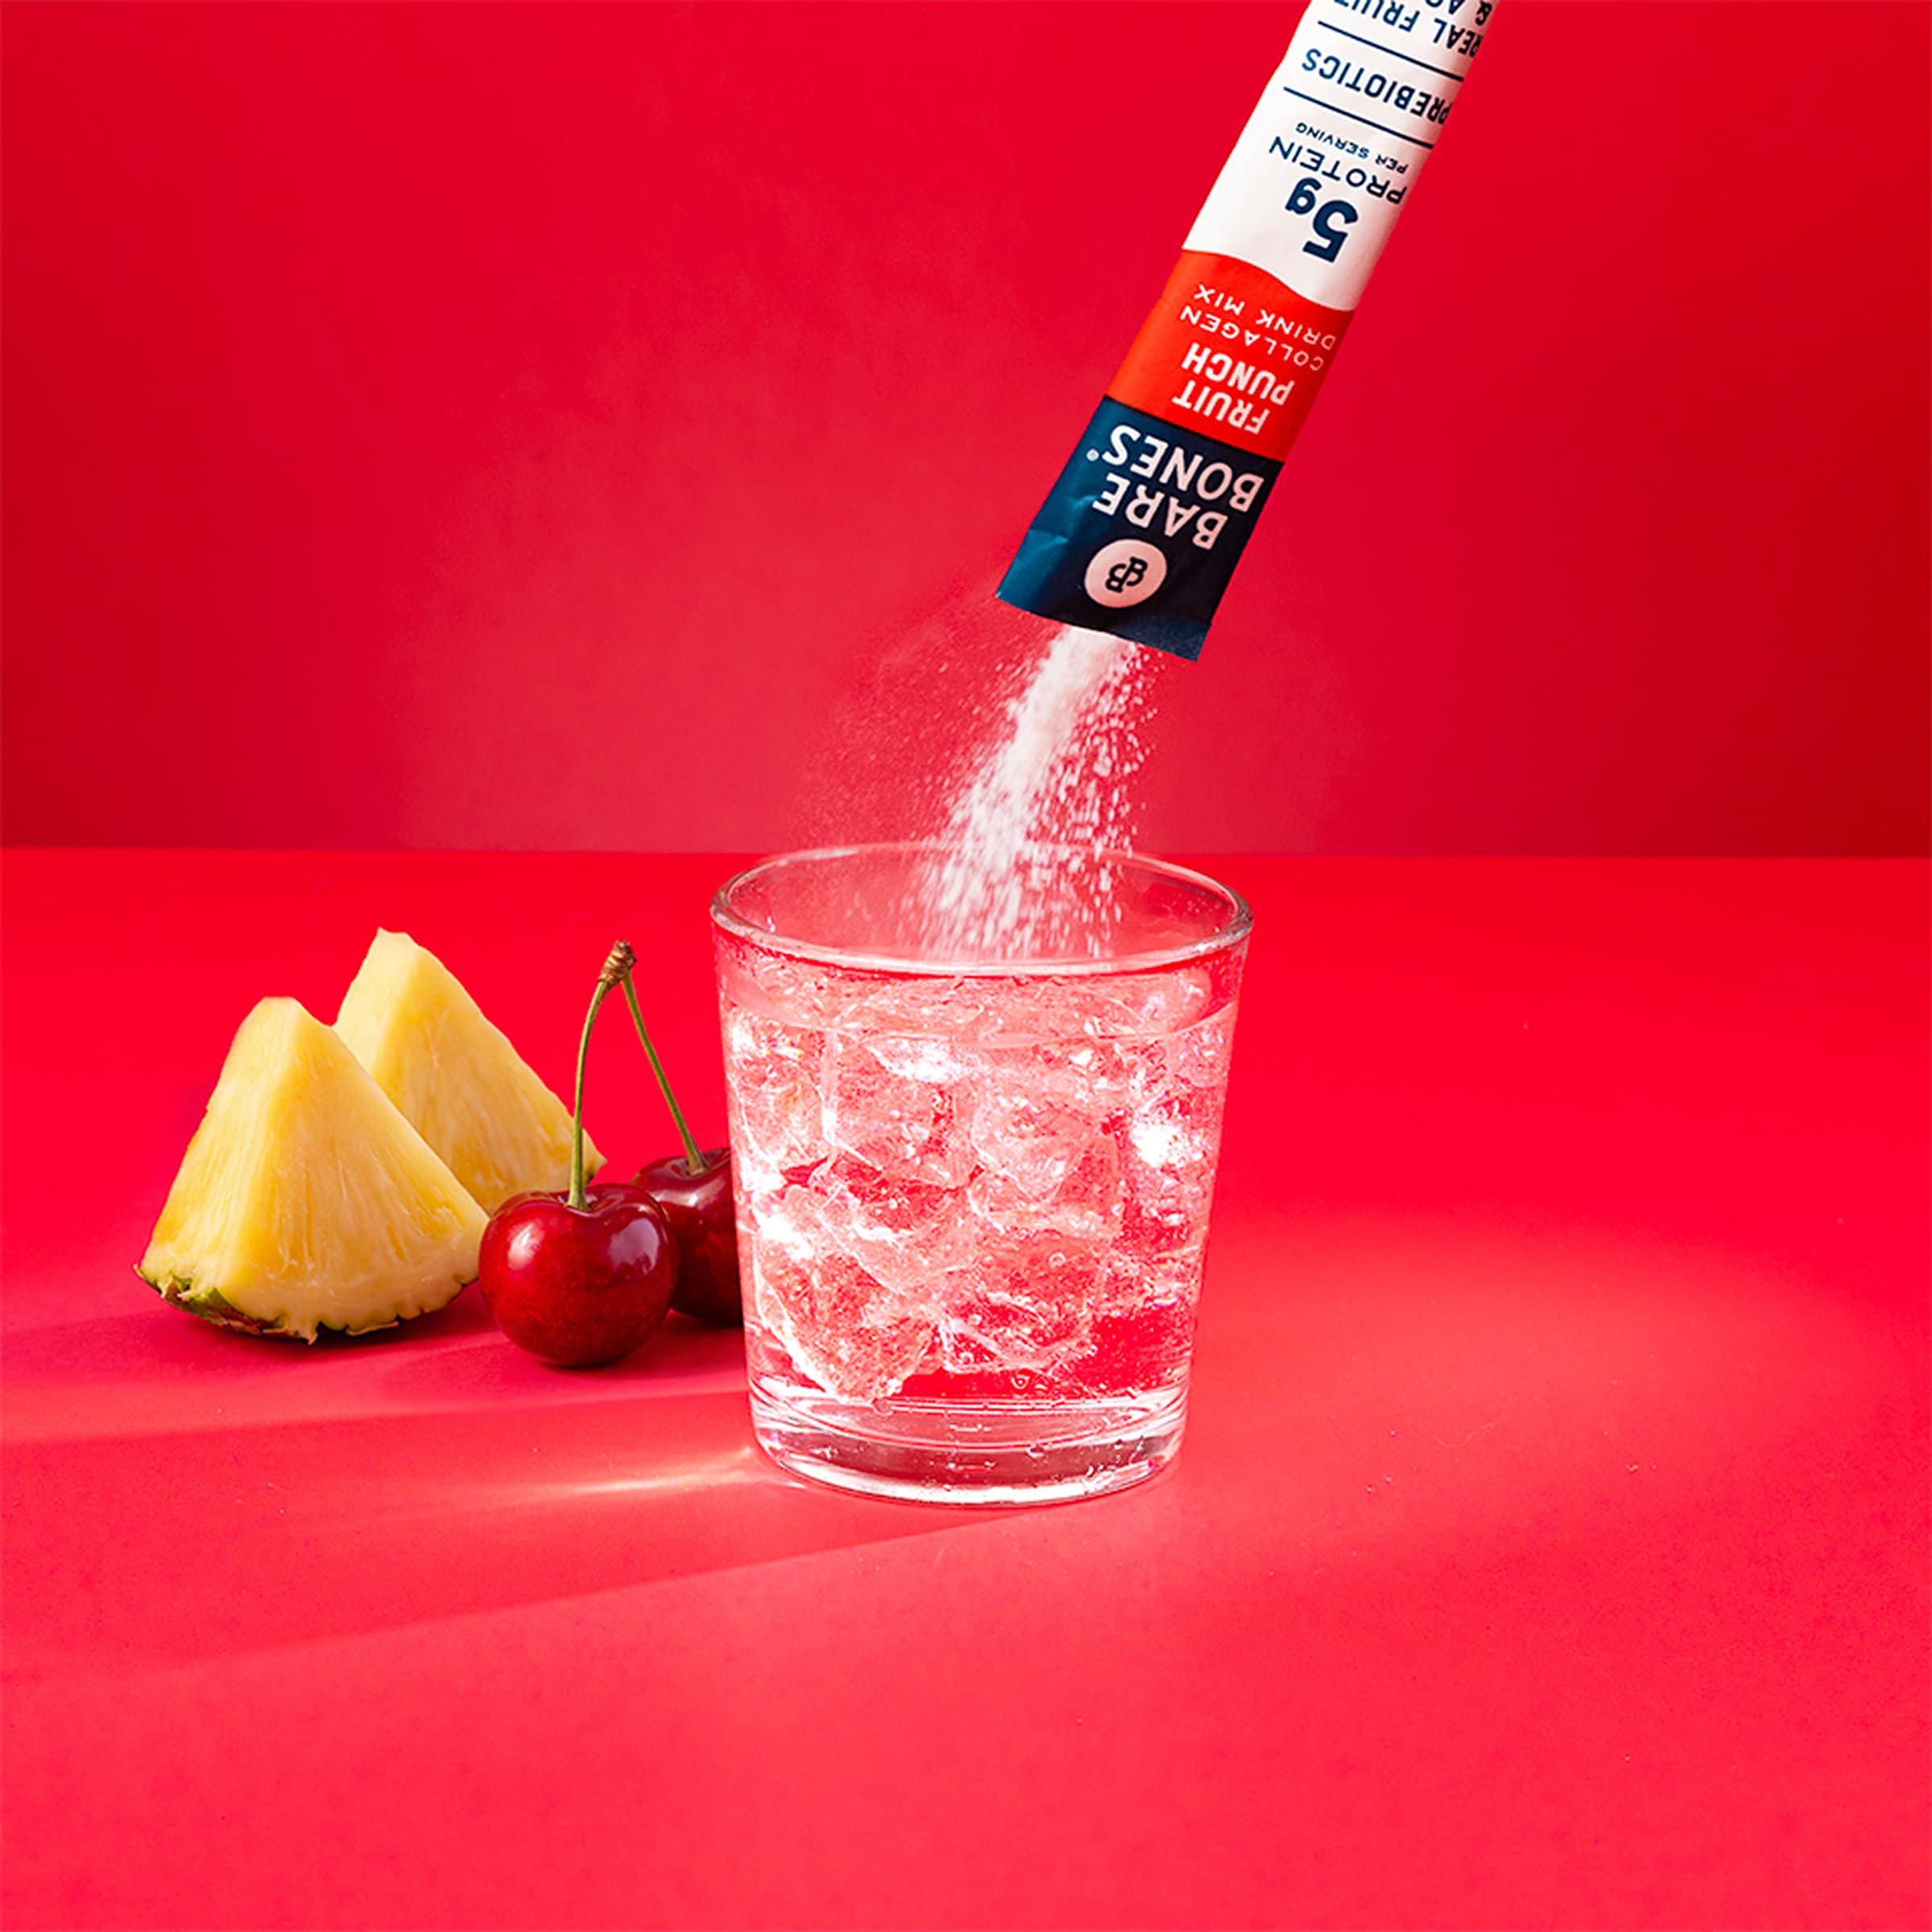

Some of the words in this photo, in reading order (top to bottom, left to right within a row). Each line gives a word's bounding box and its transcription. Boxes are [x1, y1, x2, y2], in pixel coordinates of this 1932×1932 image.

[1433, 18, 1484, 58] REAL
[1301, 47, 1453, 125] PREBIOTICS
[1269, 135, 1409, 204] PROTEIN
[1295, 122, 1369, 159] SERVING
[1376, 154, 1409, 175] PER
[1284, 177, 1359, 263] 5g
[1194, 283, 1246, 312] MIX
[1179, 305, 1325, 372] COLLAGEN
[1256, 309, 1337, 351] DRINK
[1181, 341, 1295, 406] PUNCH
[1172, 379, 1270, 435] FRUIT
[1092, 472, 1229, 551] BARE
